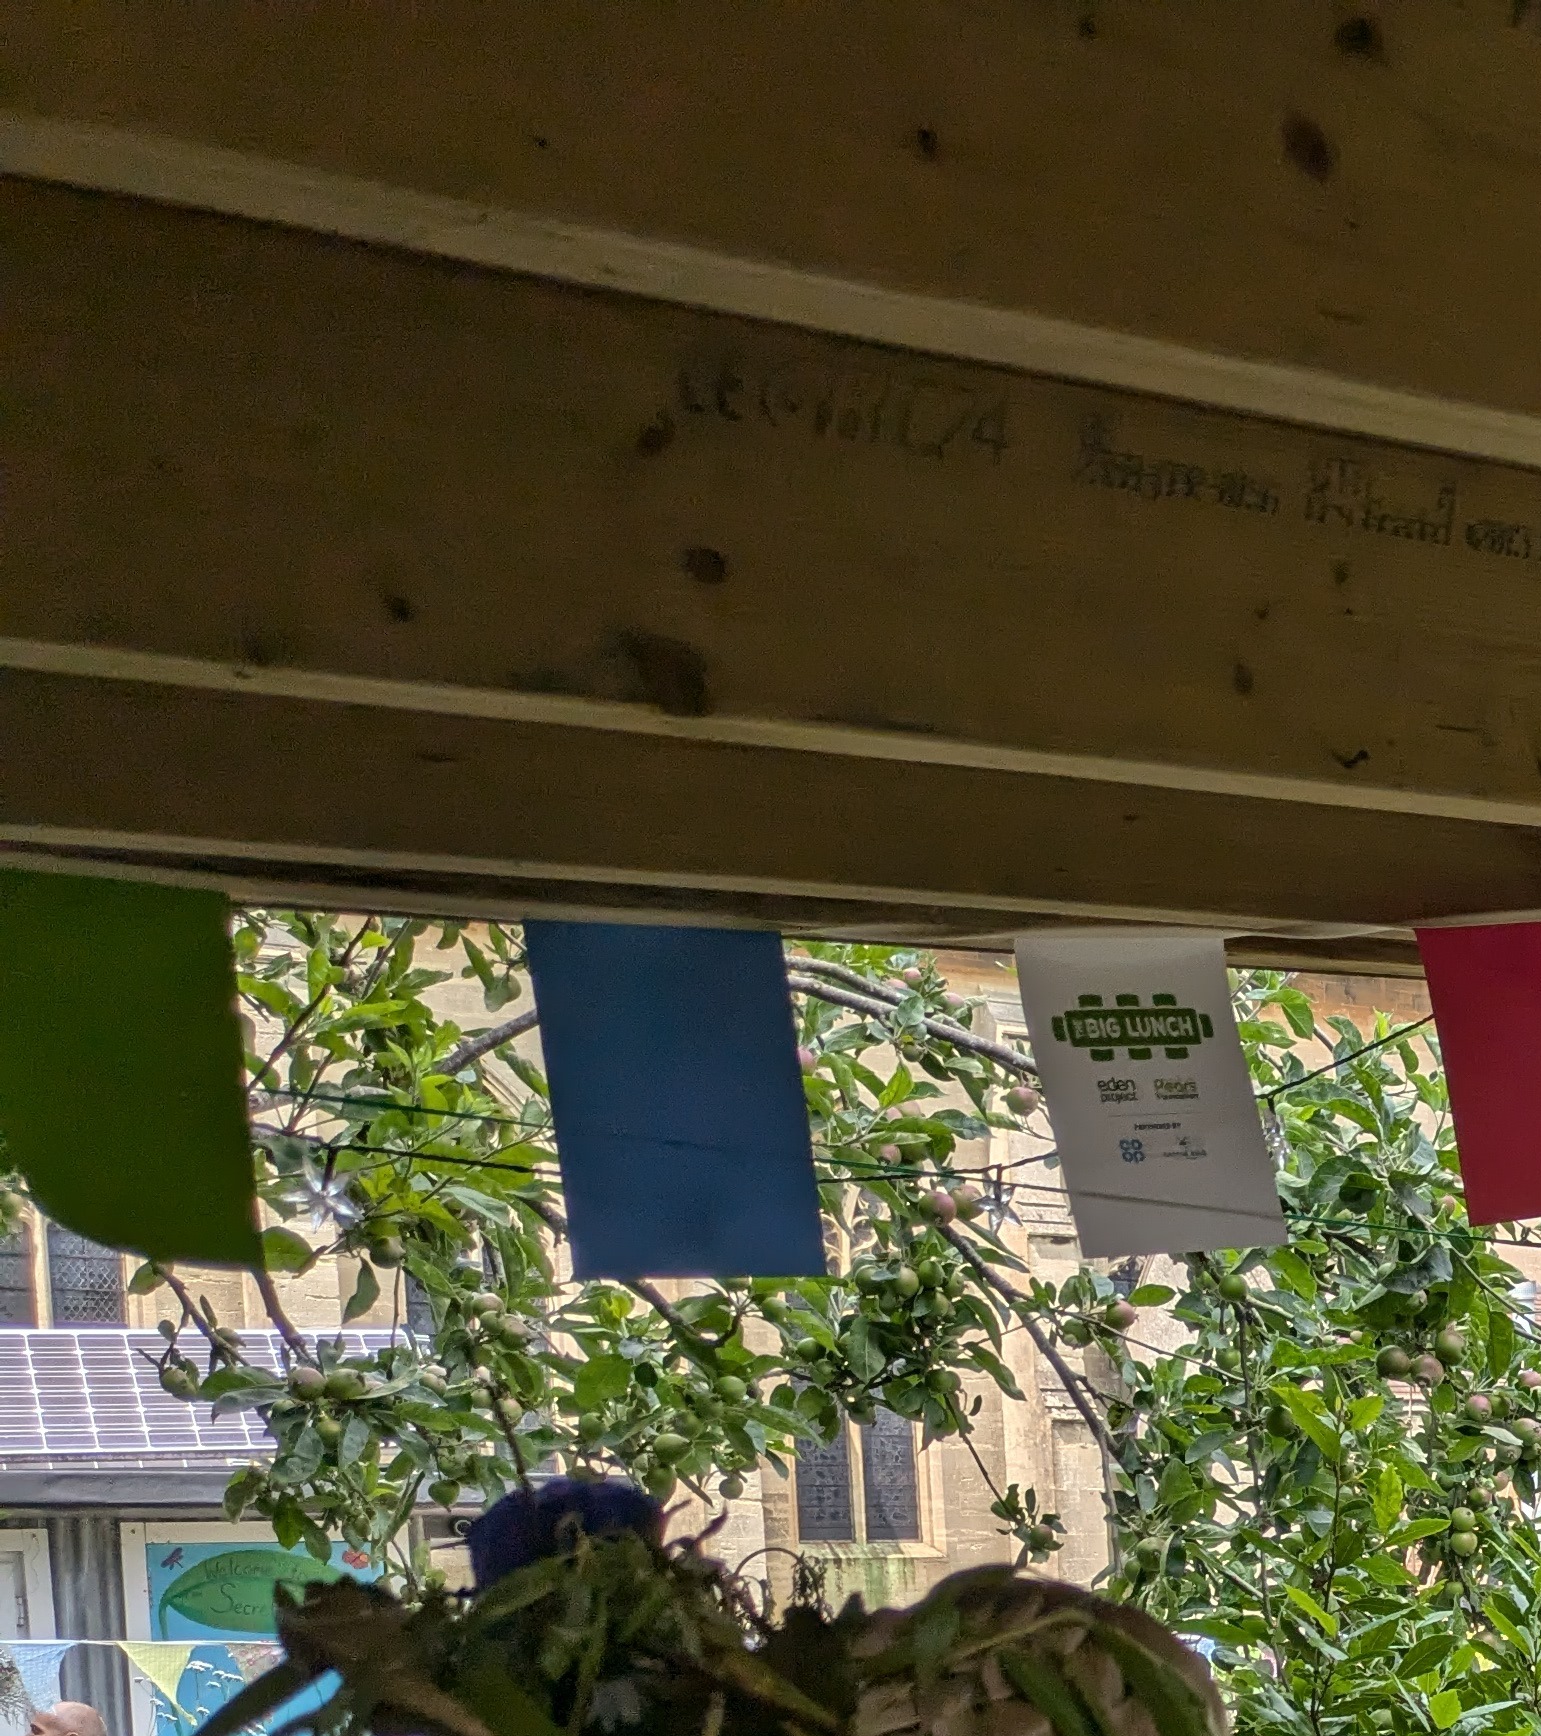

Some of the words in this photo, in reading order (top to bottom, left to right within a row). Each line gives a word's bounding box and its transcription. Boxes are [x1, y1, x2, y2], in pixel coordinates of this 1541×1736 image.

[1085, 1016, 1121, 1038] BIG
[1125, 1015, 1195, 1038] LUNCH
[1097, 1077, 1137, 1092] eden
[208, 1582, 274, 1617] Secre
